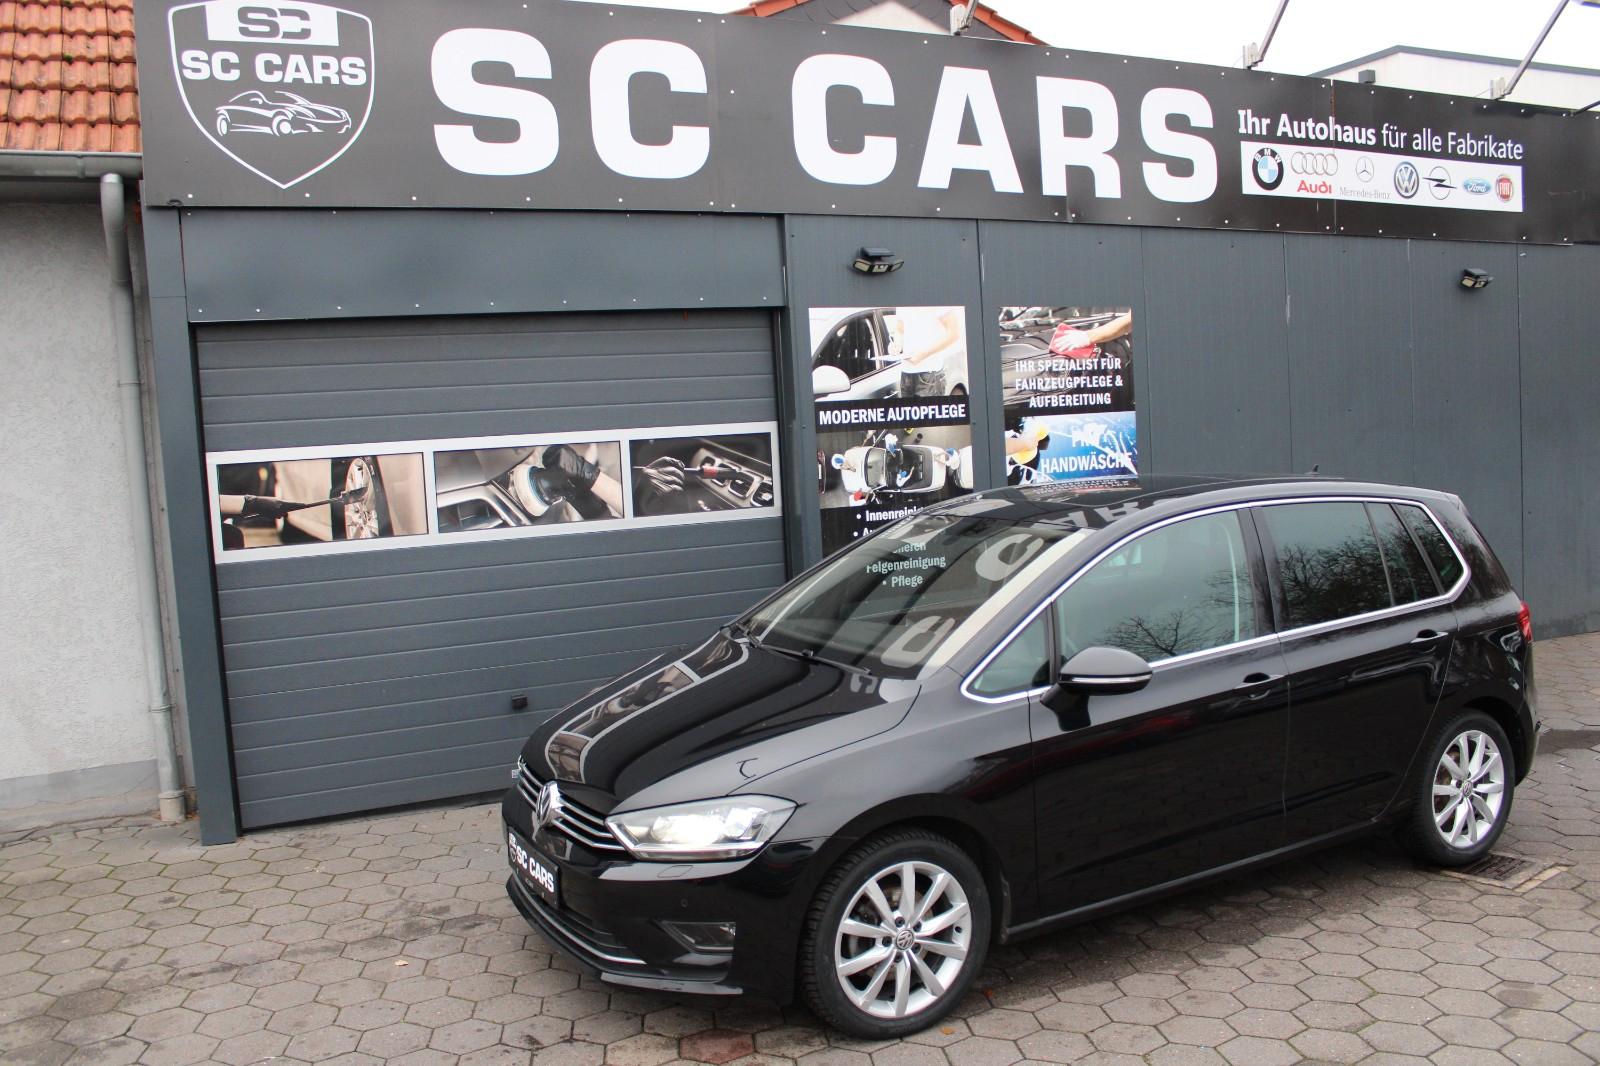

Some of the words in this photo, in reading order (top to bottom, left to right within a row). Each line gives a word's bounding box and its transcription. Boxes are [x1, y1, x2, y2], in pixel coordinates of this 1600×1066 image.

[181, 50, 241, 81] SC
[255, 53, 367, 86] CARS
[431, 27, 710, 179] SC
[791, 53, 1218, 203] CARS
[1238, 109, 1271, 137] Ihr
[1276, 113, 1377, 146] Autohaus
[1381, 123, 1408, 150] für
[1412, 128, 1443, 153] alle
[1447, 131, 1524, 160] Fabrikate
[1296, 180, 1332, 194] Audi
[1467, 182, 1487, 193] Ford
[1015, 361, 1035, 373] IHR
[1038, 359, 1098, 371] SPEZIALIST
[1101, 357, 1121, 369] FÜR
[1015, 375, 1112, 391] FAHRZEUGPFLEGE
[1115, 374, 1124, 387] &
[1029, 393, 1111, 407] AUFBEREITUNG
[819, 408, 885, 425] MODERNE
[887, 404, 966, 421] AUTOPFLEGE
[1041, 451, 1133, 474] HANDWÄSCHE
[891, 575, 923, 588] Pflege
[516, 845, 528, 869] SC
[529, 857, 555, 893] CARS
